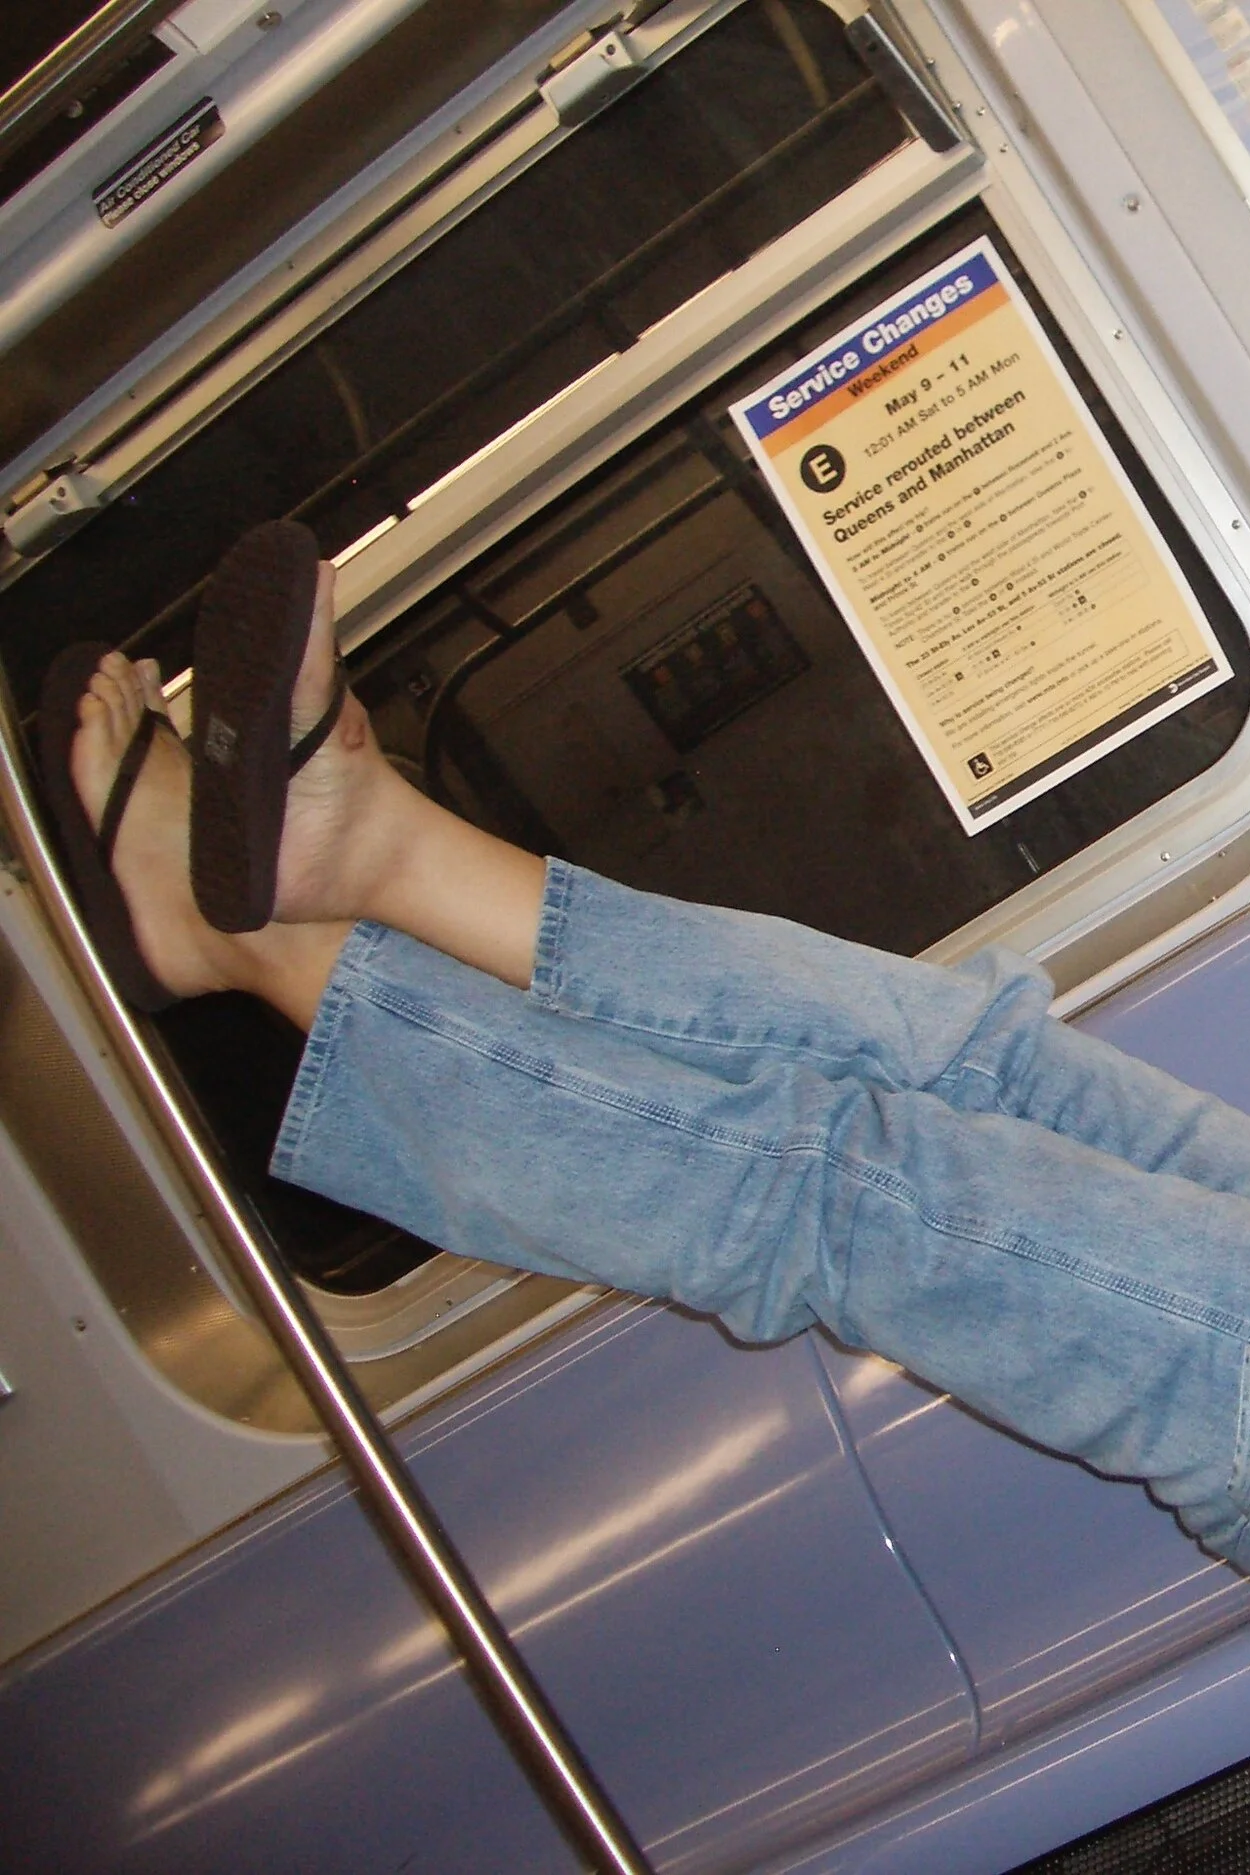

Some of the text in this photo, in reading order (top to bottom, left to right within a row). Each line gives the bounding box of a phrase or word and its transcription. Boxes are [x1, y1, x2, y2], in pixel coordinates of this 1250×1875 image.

[100, 124, 199, 213] Air Conditioned Car
[133, 175, 159, 199] close
[158, 141, 199, 177] windows
[768, 275, 973, 418] Service Changes
[846, 343, 918, 397] Weekend
[884, 389, 917, 415] May
[920, 378, 931, 391] 9
[949, 353, 969, 371] 11
[863, 352, 1019, 457] 12:01 AM Sat to 5 AM Mon
[809, 453, 837, 484] E
[822, 390, 1025, 525] Service rerouted between
[833, 422, 1014, 542] Queens and Manhattan
